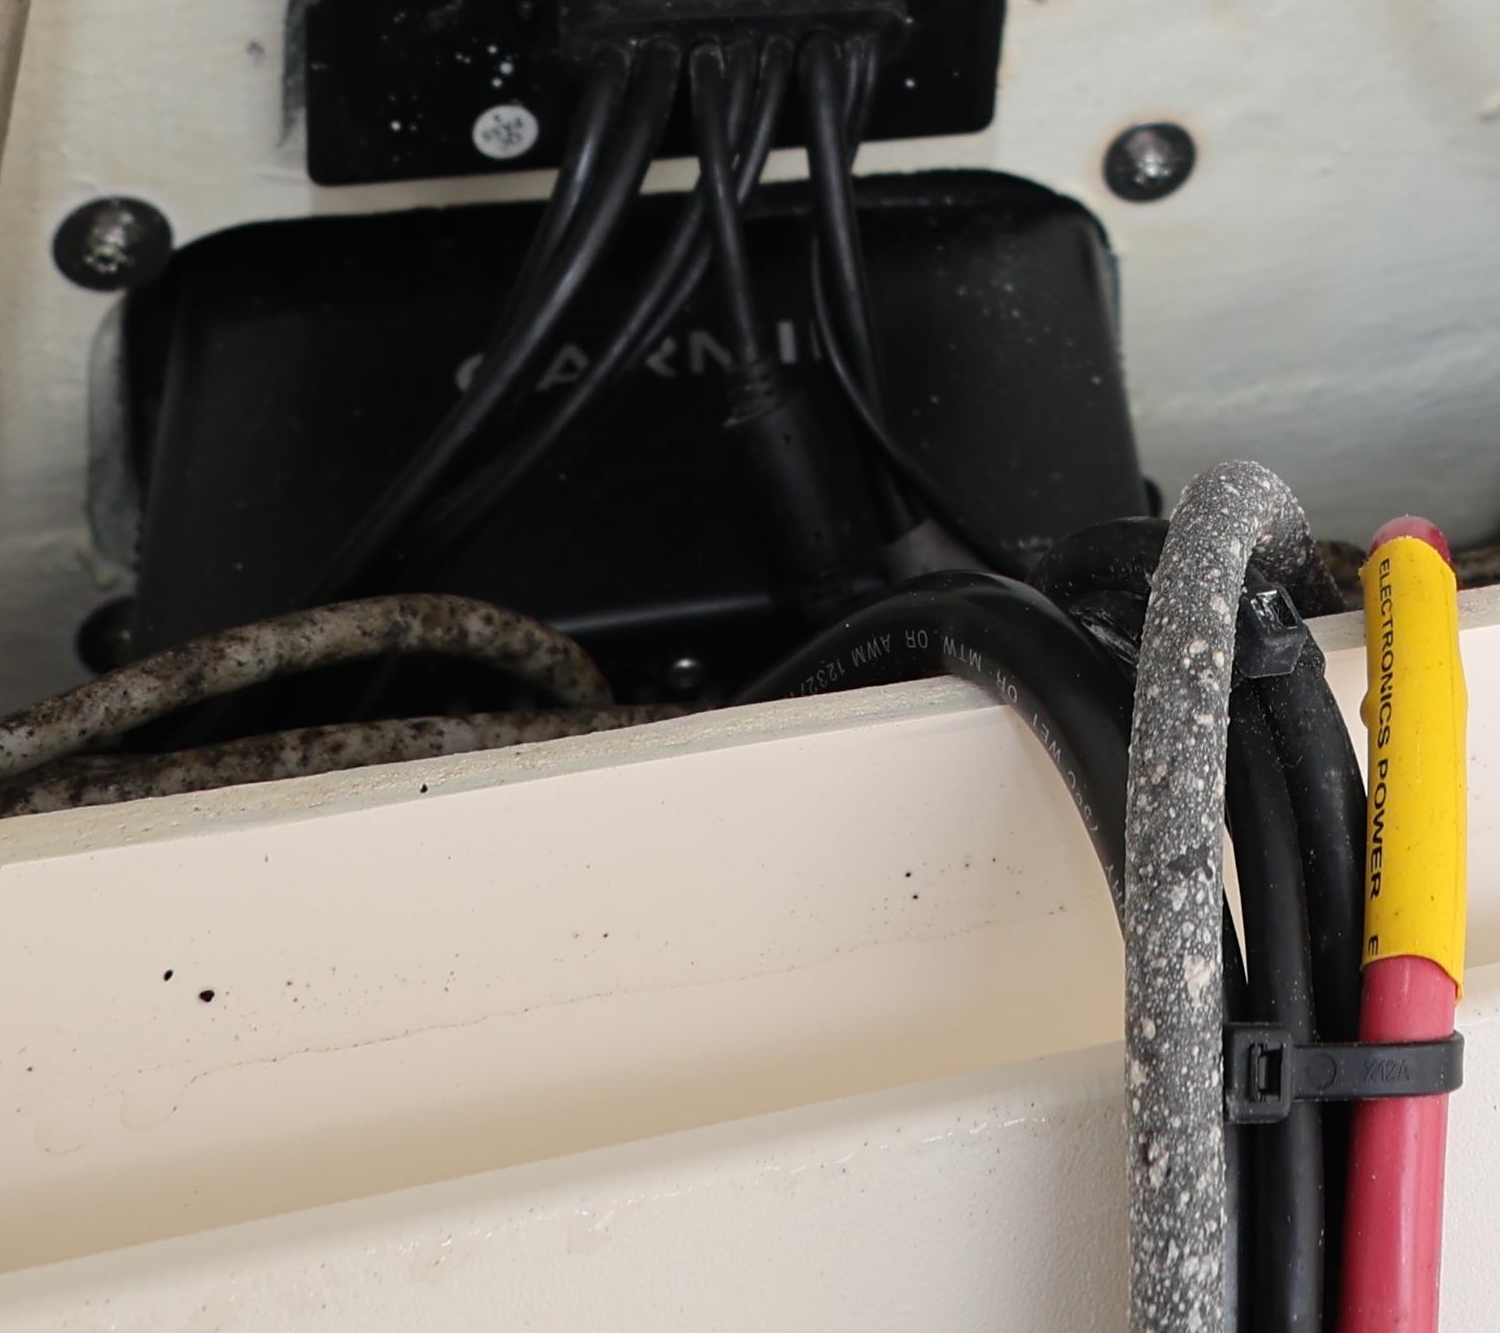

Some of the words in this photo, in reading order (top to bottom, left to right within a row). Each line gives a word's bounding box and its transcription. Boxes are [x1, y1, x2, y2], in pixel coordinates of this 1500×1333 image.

[851, 634, 891, 668] AWM
[905, 629, 929, 648] OR
[942, 635, 983, 672] MTW
[1376, 557, 1394, 750] ELECTRONICS
[996, 669, 1019, 705] OR
[1369, 759, 1389, 902] POWER
